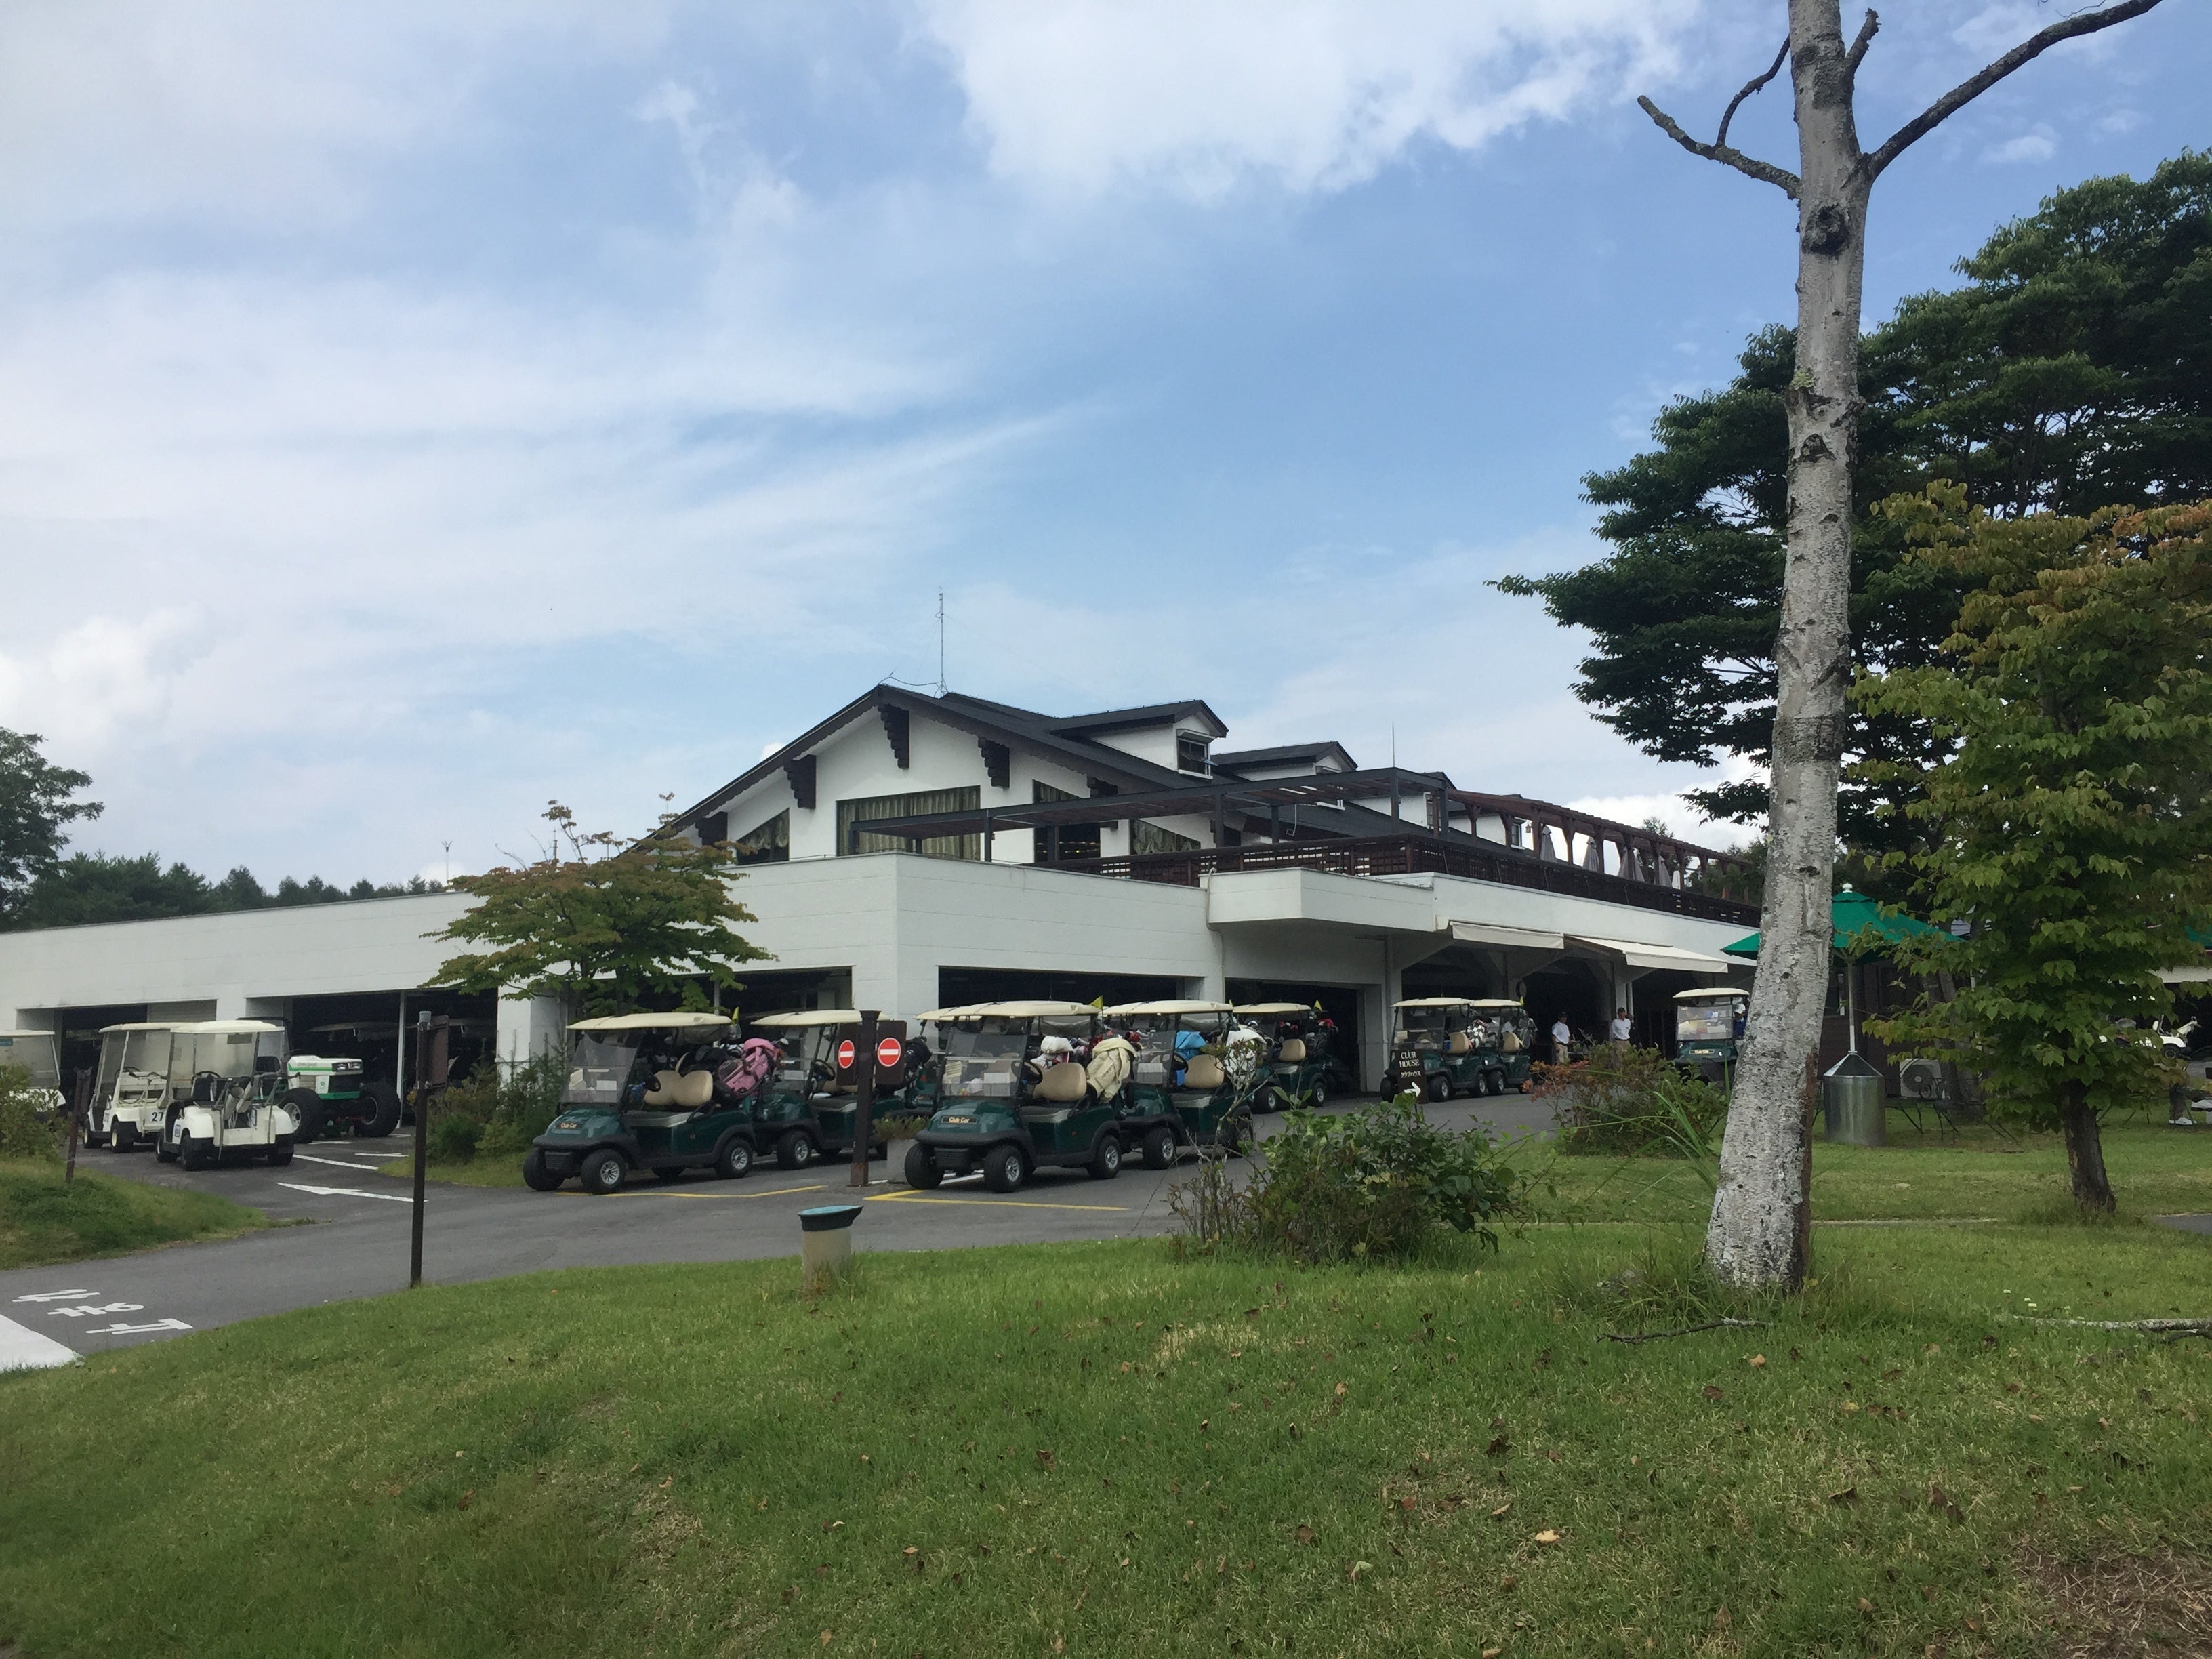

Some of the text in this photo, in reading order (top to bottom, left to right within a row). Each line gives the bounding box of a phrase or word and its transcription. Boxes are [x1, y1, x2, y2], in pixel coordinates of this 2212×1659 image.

[1400, 1051, 1416, 1059] CLUB
[1399, 1059, 1420, 1068] HOUSE
[152, 1112, 164, 1122] 27
